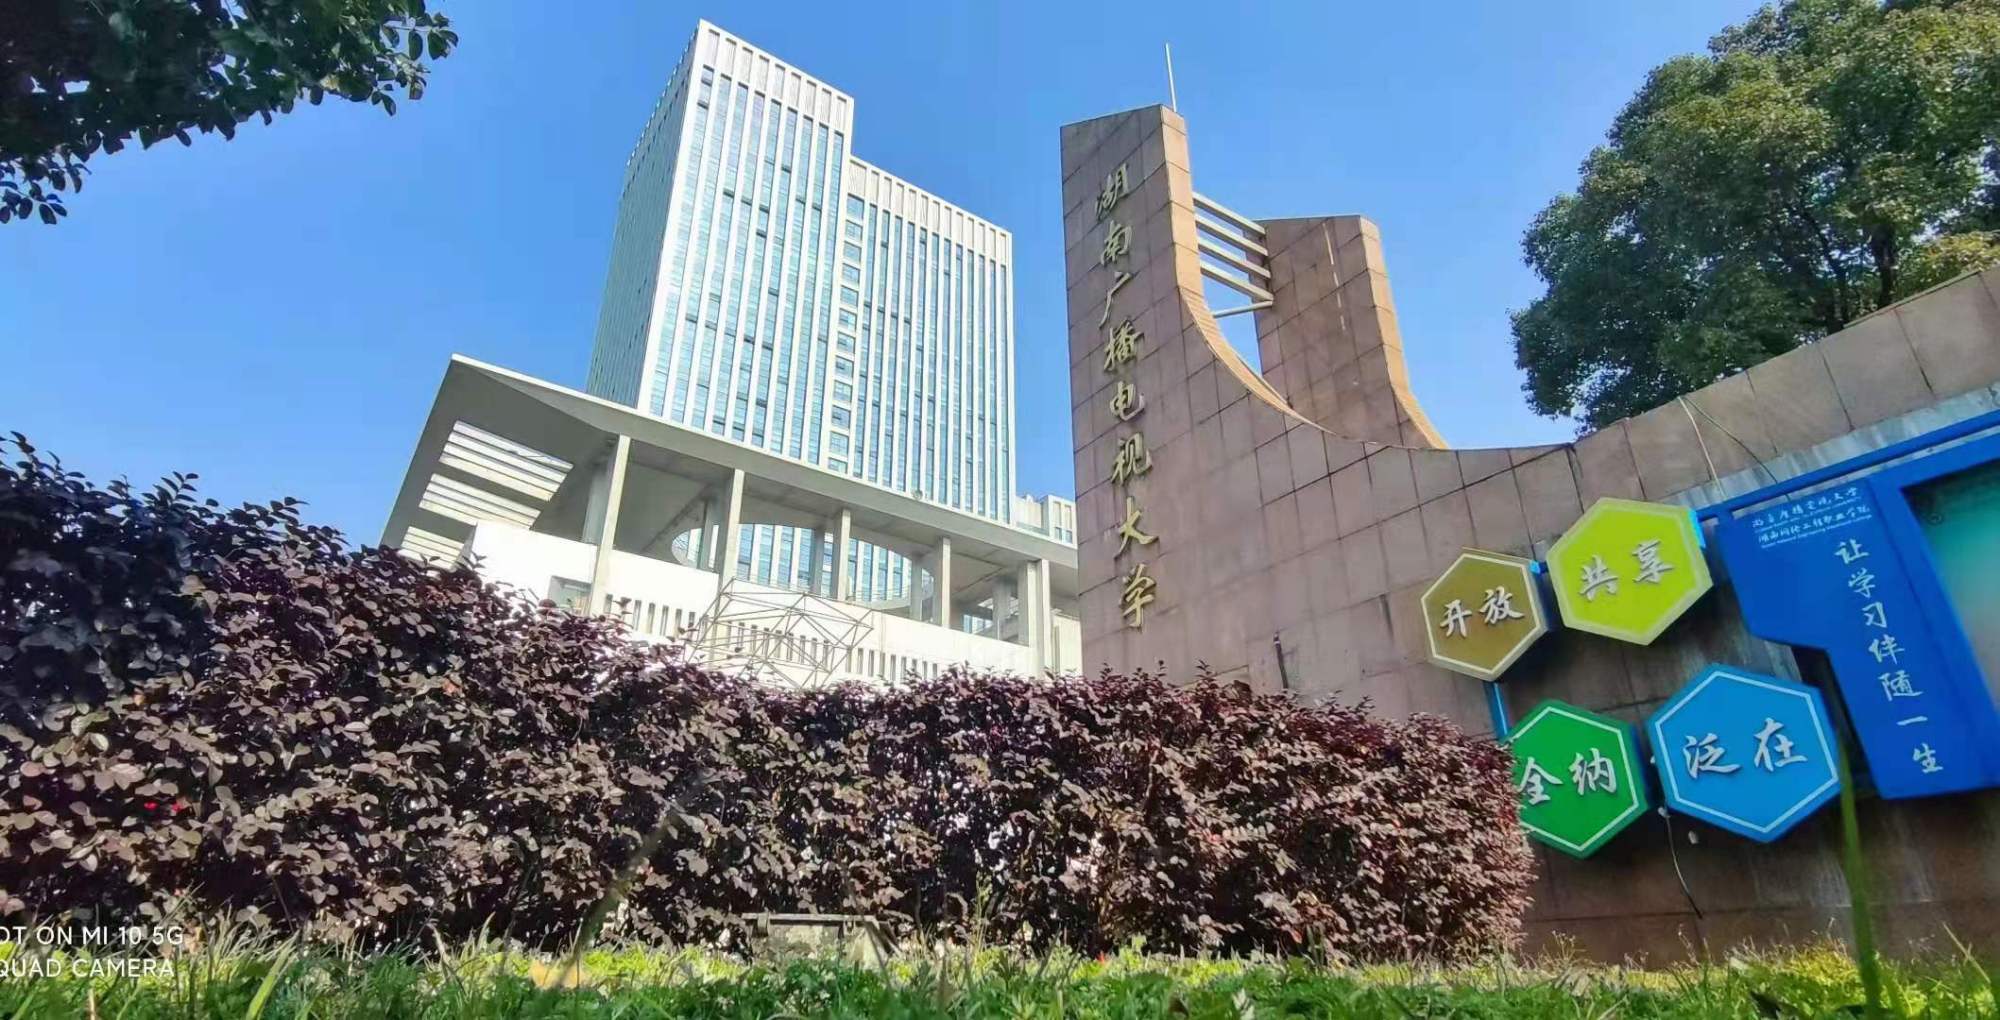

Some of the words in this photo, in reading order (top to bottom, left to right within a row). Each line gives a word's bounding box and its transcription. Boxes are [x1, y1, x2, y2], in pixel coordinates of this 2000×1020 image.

[1094, 161, 1158, 629] 湖南广播电视大学
[1579, 538, 1675, 600] 共享
[1439, 586, 1525, 638] 开放
[1834, 538, 1944, 774] 让学习伴随一生
[1516, 747, 1617, 806] 全纳
[1681, 717, 1810, 781] 泛在
